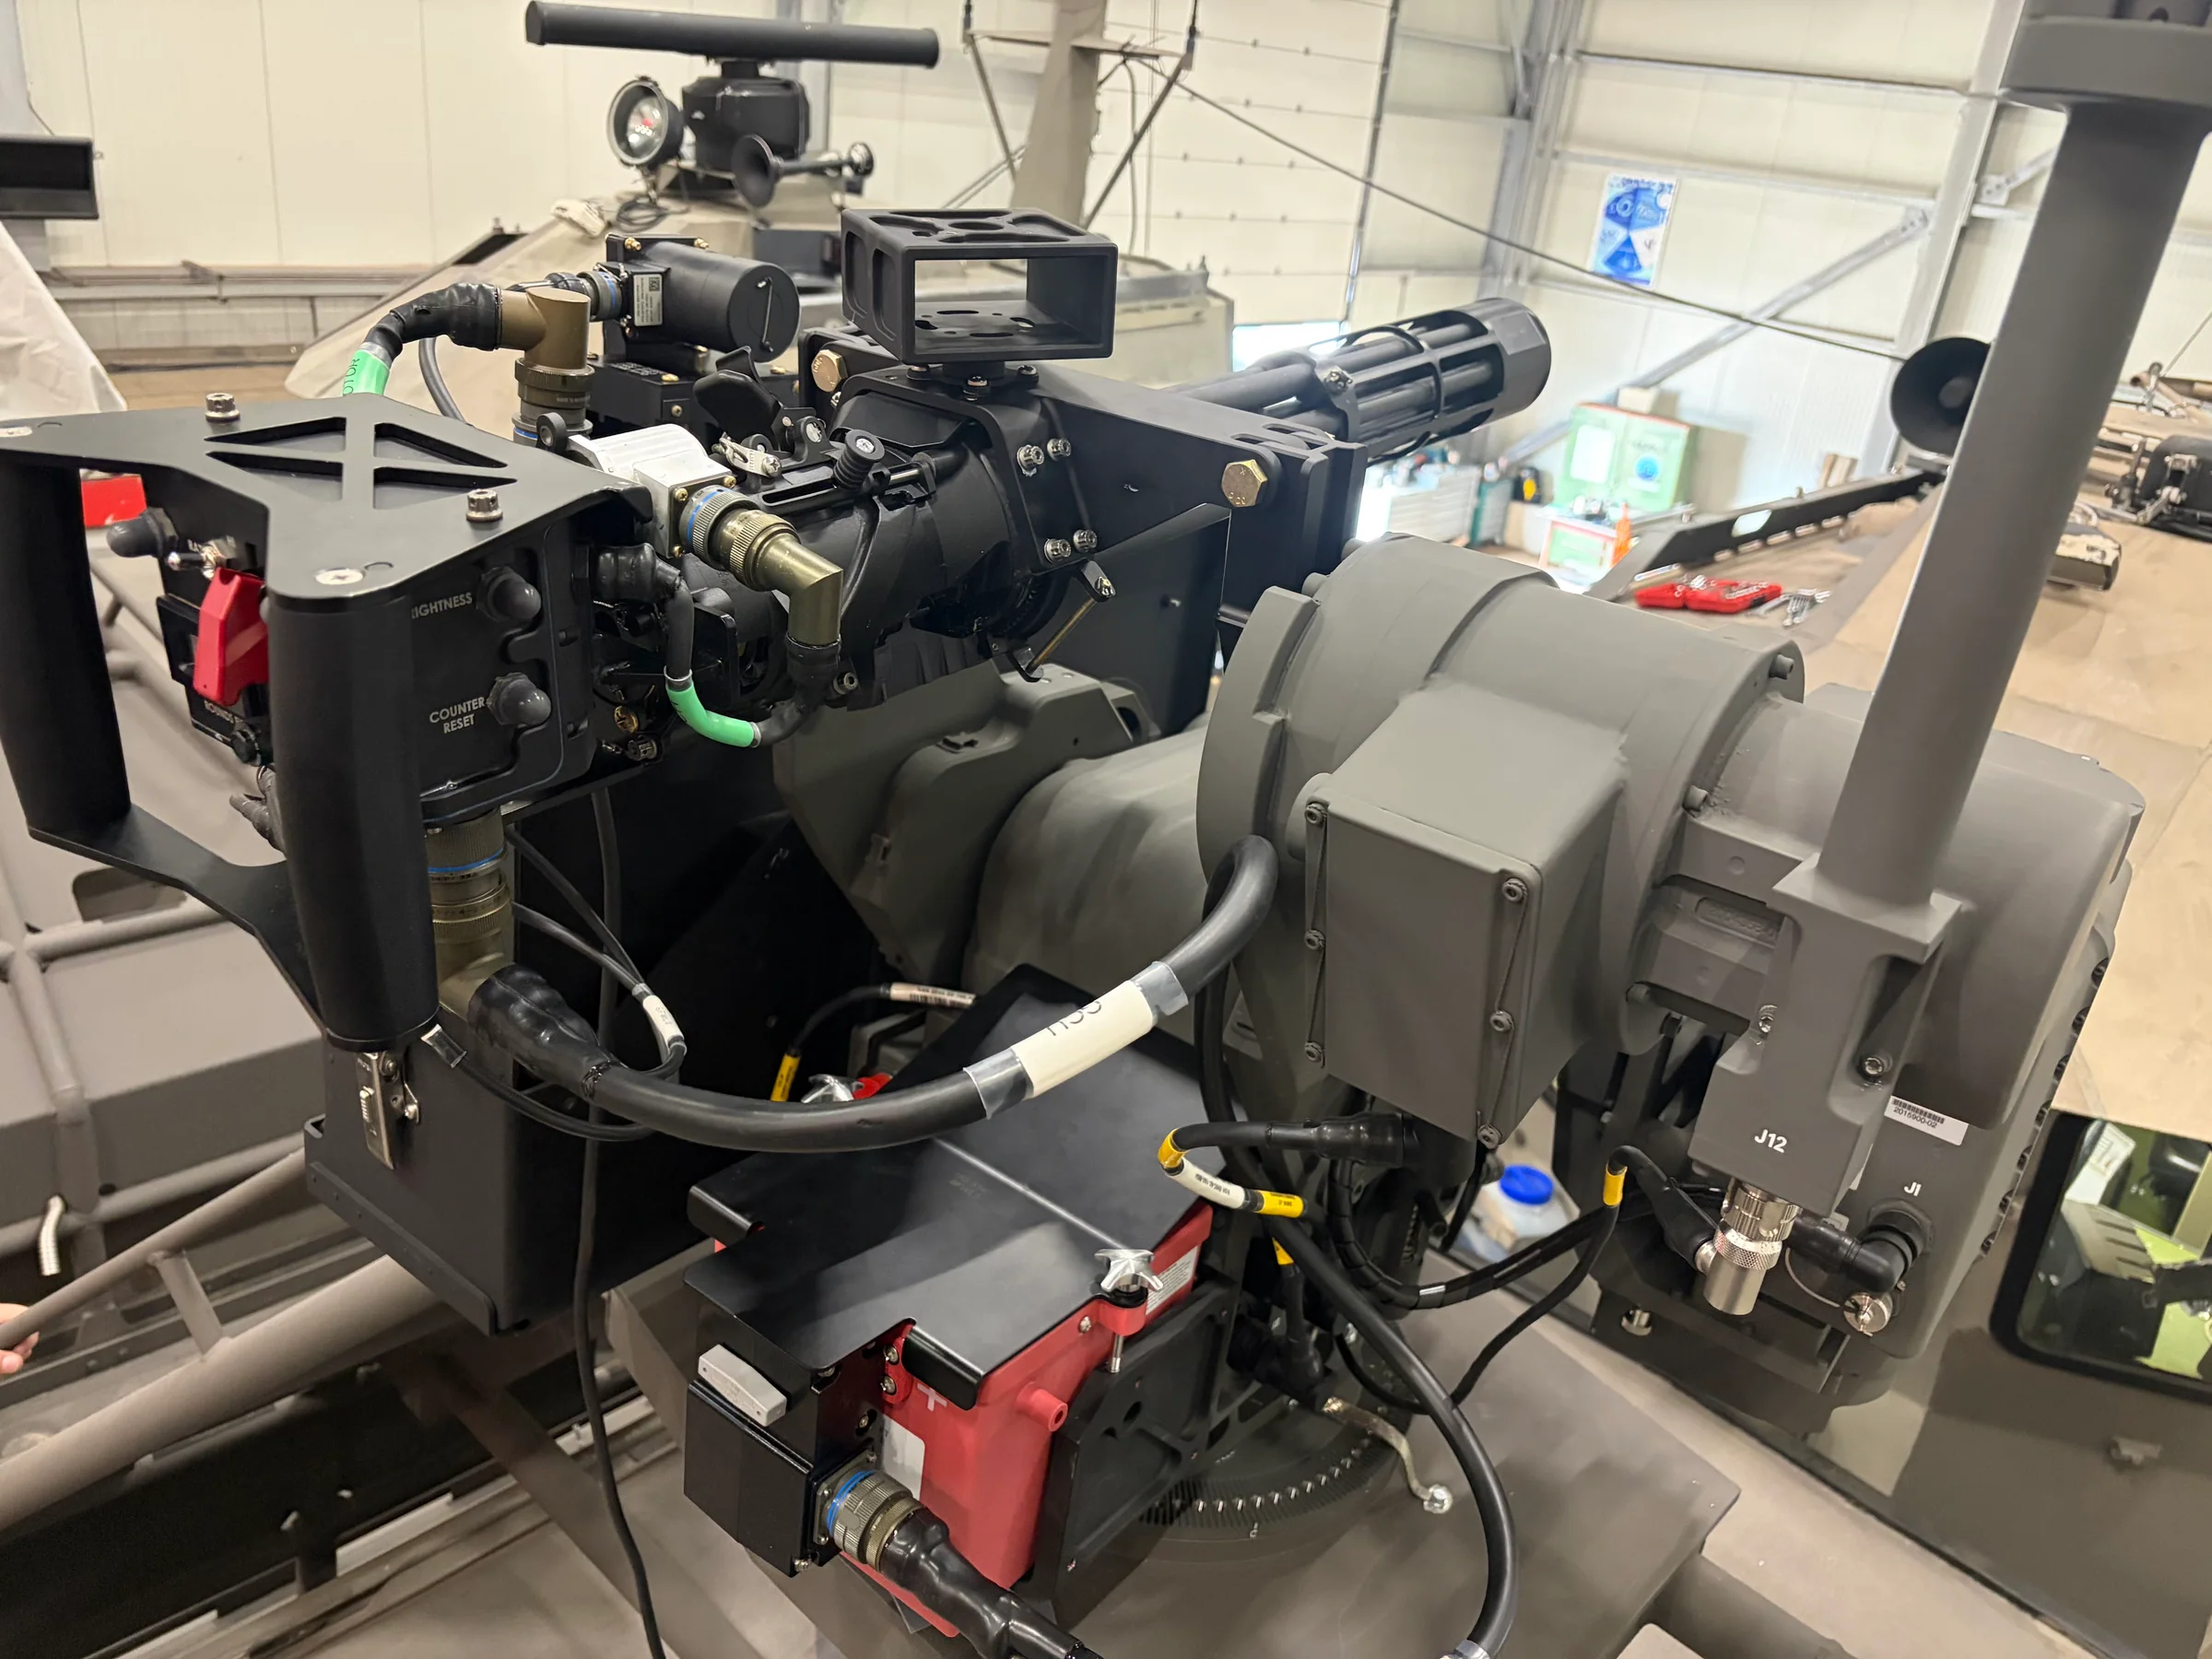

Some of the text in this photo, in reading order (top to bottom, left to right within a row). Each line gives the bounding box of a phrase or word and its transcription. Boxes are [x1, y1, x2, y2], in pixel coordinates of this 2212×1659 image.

[429, 696, 485, 724] COUNTER
[443, 713, 475, 734] RESET
[1893, 1106, 1937, 1129] 2015900-02
[1754, 1129, 1787, 1153] J12
